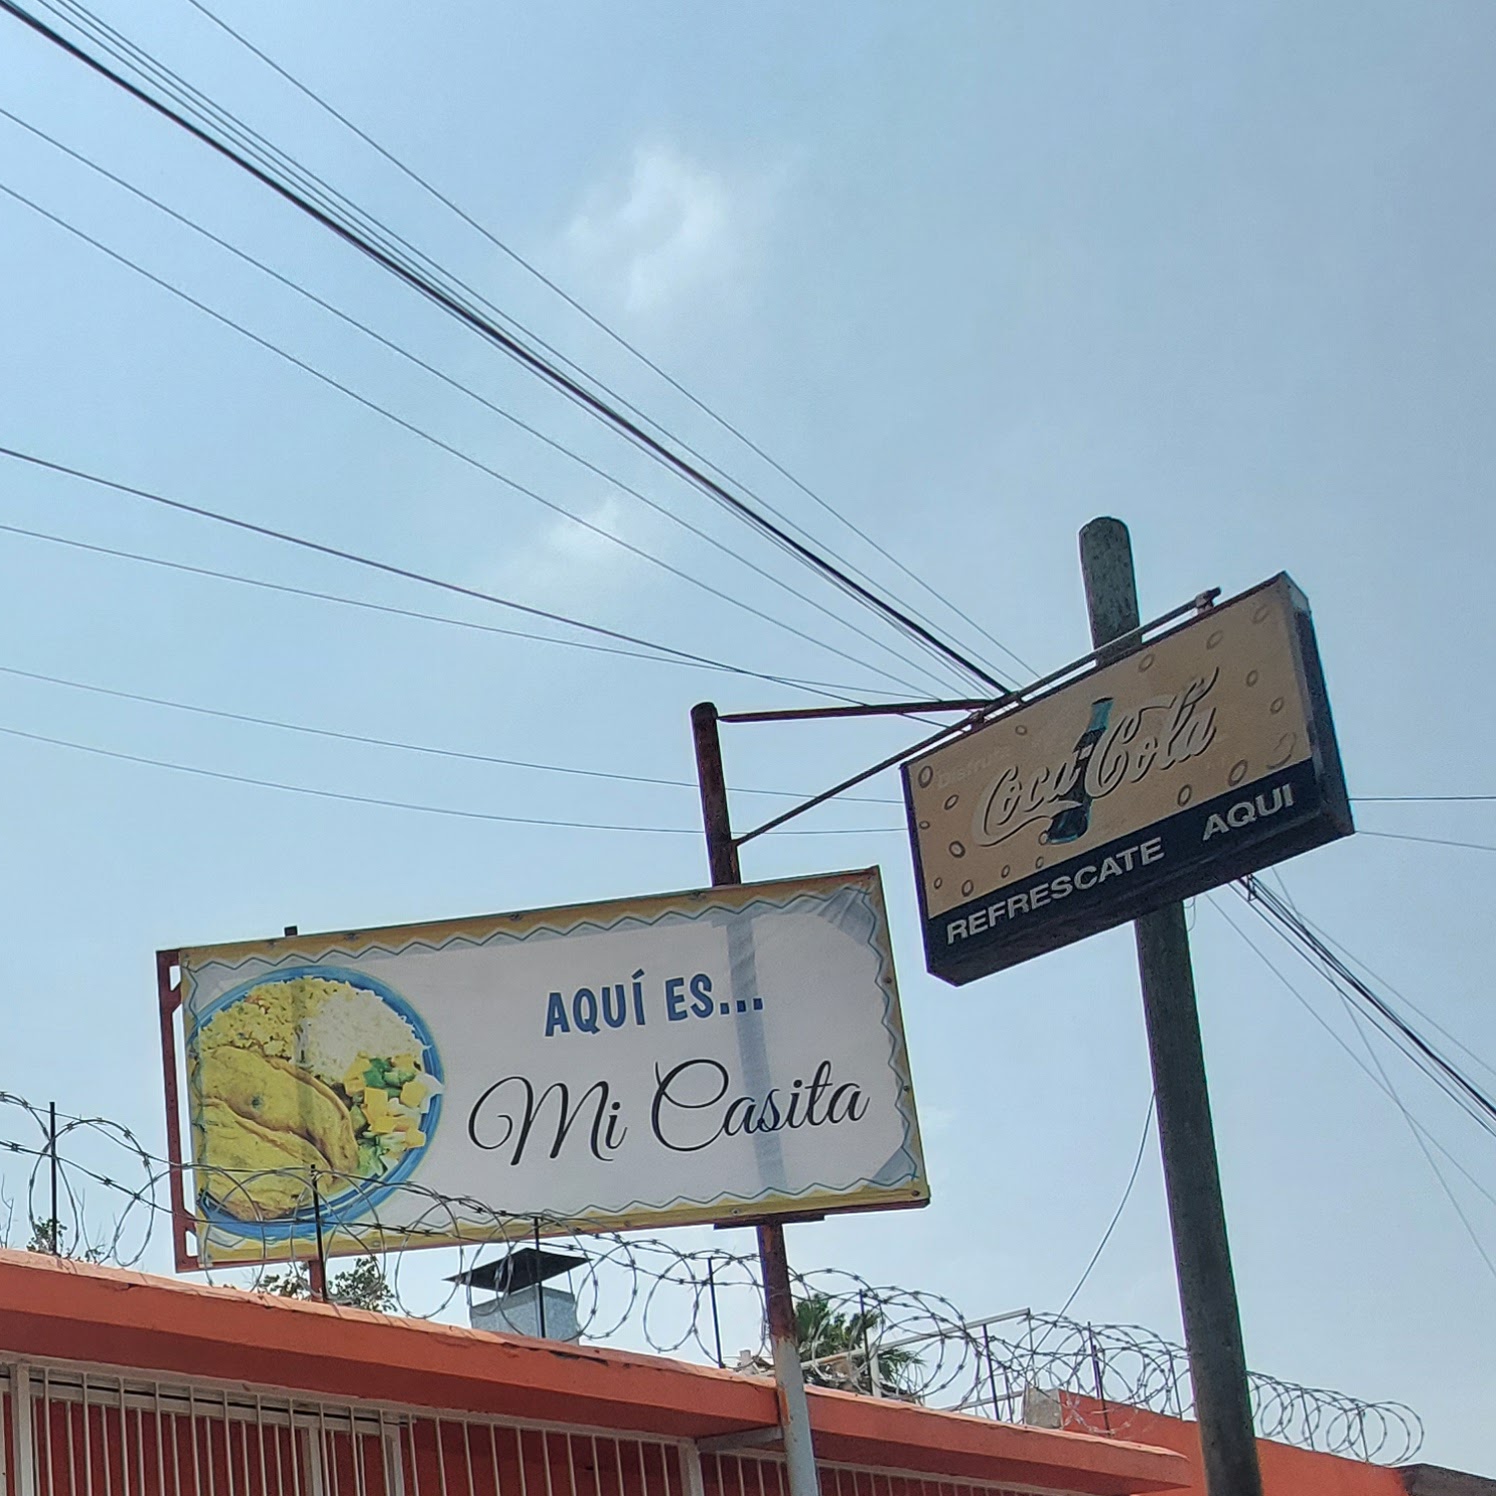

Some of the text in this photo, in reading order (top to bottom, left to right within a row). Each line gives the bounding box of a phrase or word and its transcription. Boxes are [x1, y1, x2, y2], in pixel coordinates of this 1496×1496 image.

[946, 783, 1294, 945] REFRESCATE AQUI
[544, 968, 764, 1037] AQUÍ ES...
[468, 1058, 870, 1166] Mi Casita
